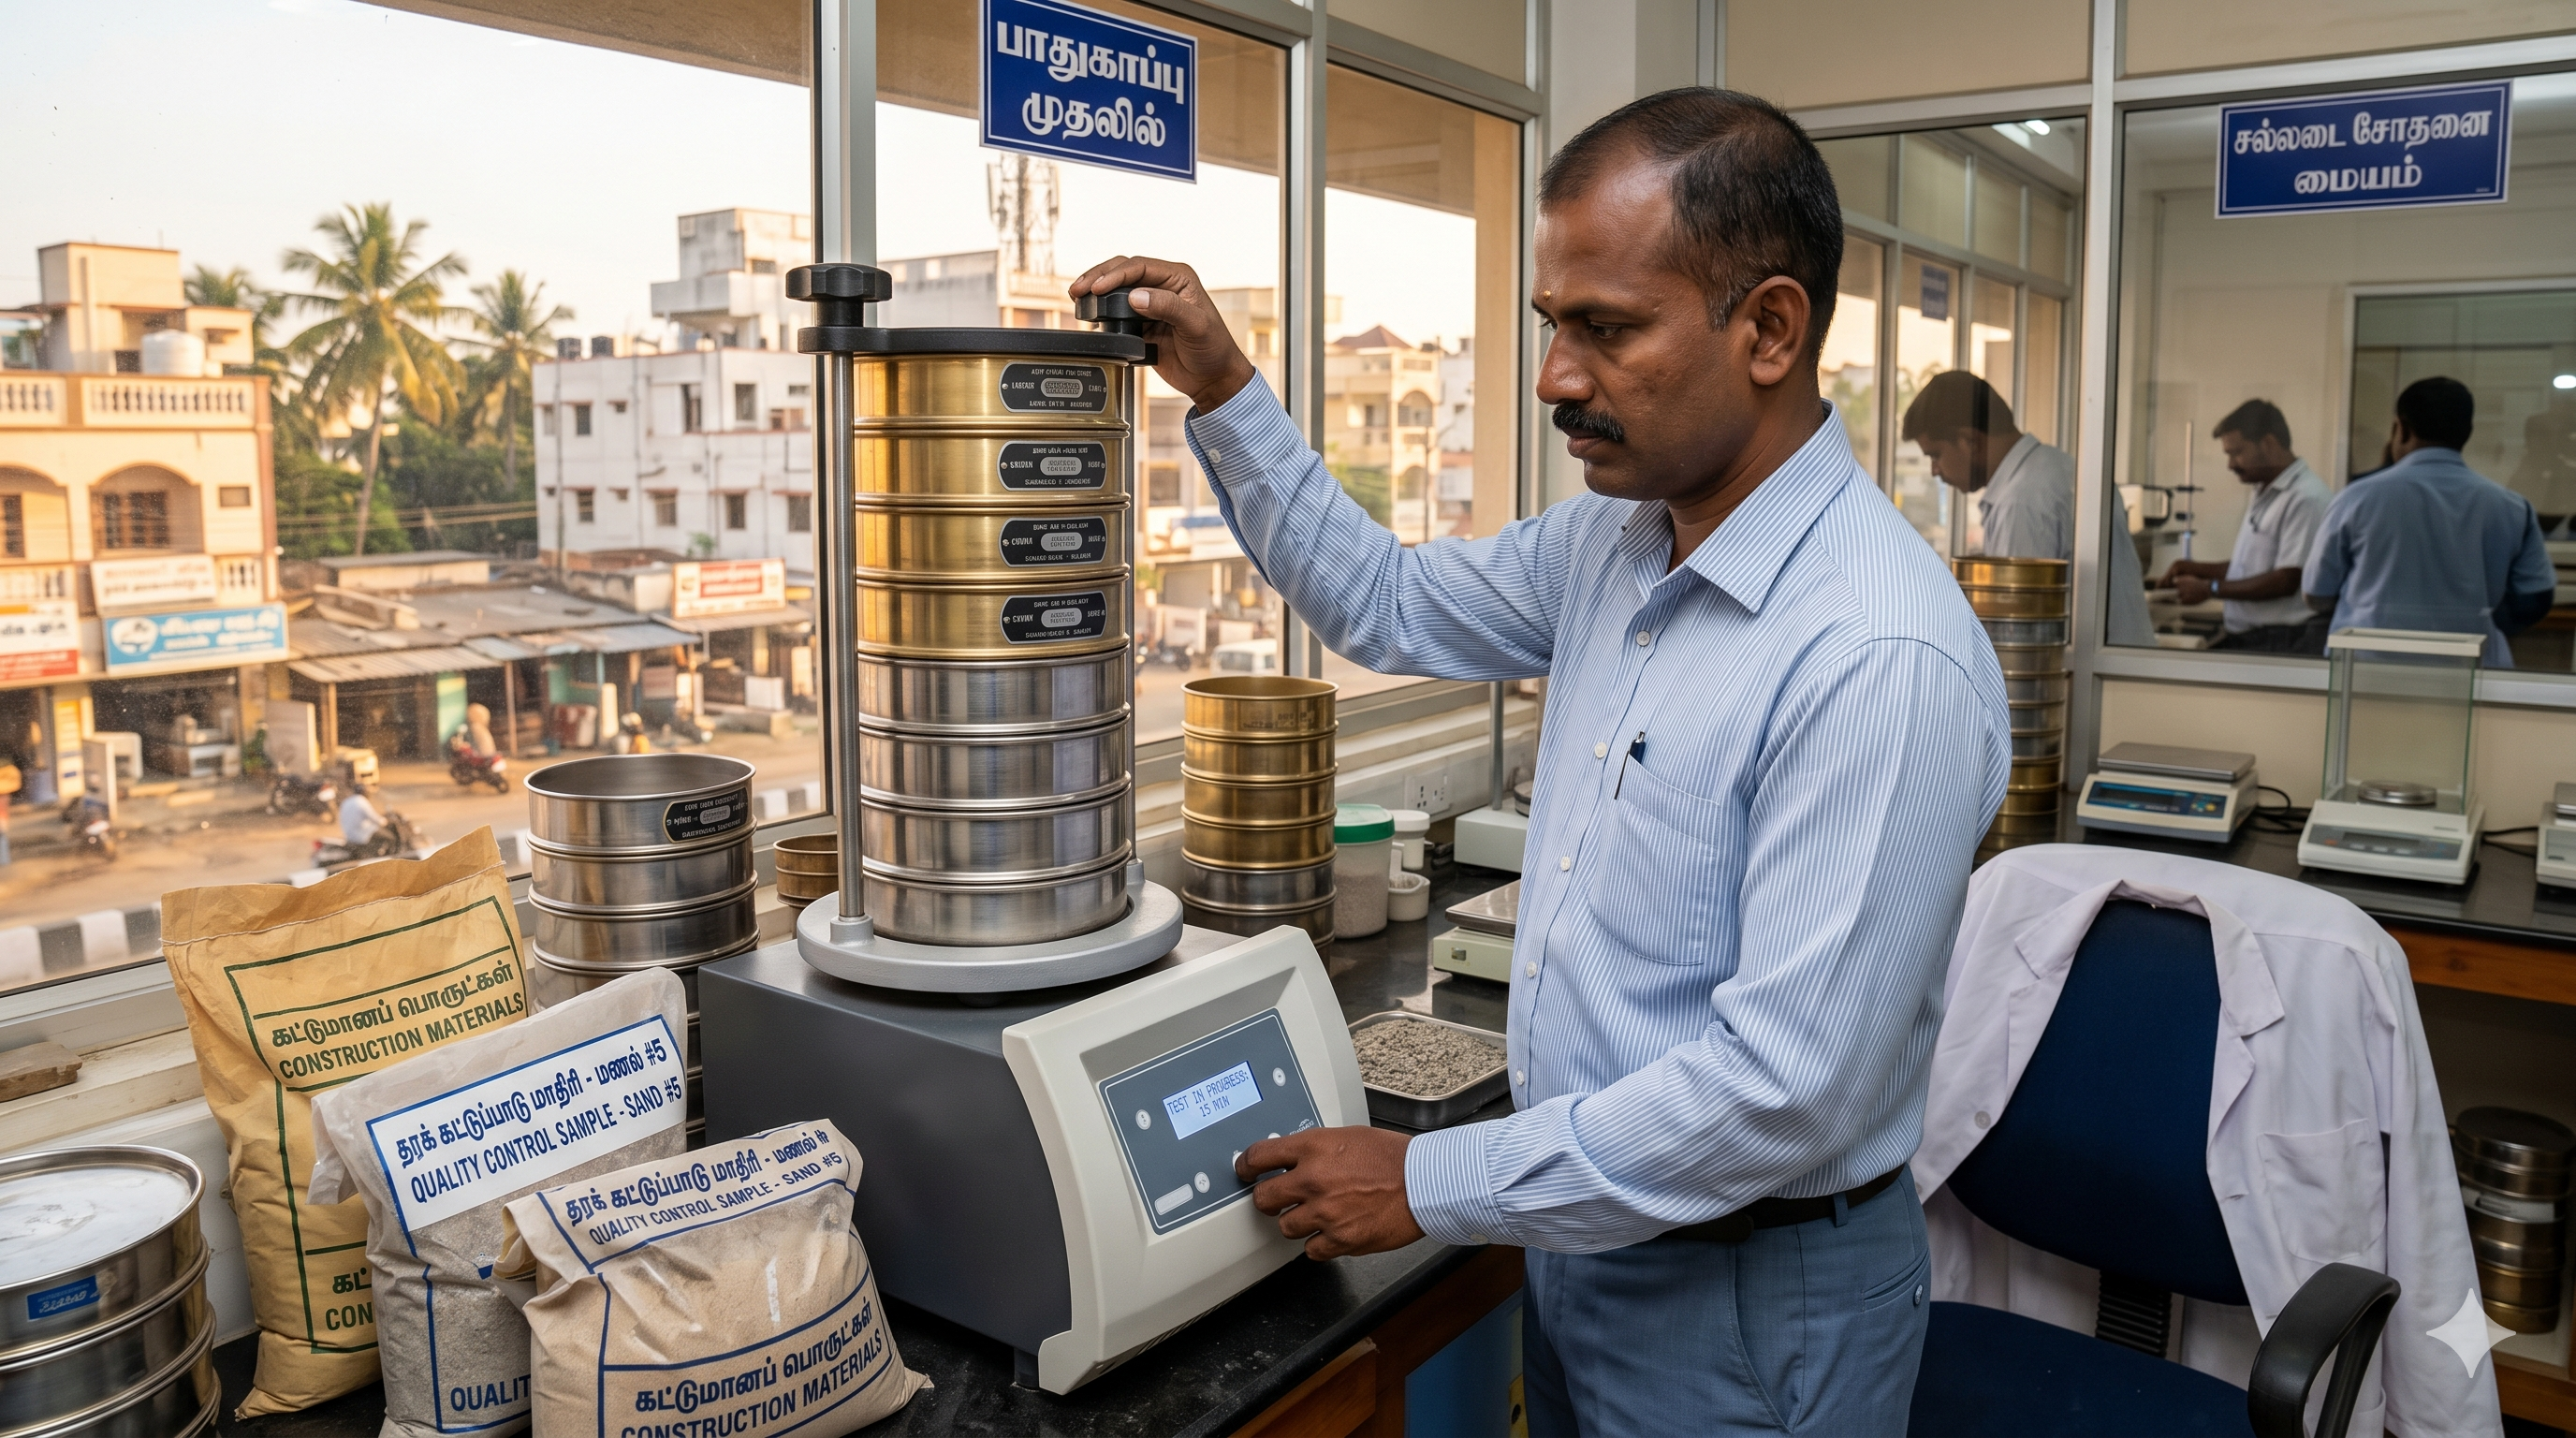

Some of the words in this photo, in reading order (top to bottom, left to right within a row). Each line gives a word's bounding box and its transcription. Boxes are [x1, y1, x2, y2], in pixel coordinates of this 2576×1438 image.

[997, 21, 1184, 104] பாதுகாப்பு
[1022, 92, 1165, 147] முதலில்
[2234, 118, 2346, 154] சல்லடை
[2352, 110, 2492, 151] சோதனை
[2293, 154, 2422, 194] மையம்
[272, 999, 393, 1046] கட்டுமானப்
[398, 960, 514, 1018] பொருட்கள்
[279, 1028, 424, 1079] CONSTRUCTION
[425, 991, 524, 1043] MATERIALS
[396, 1123, 437, 1169] தரக்
[438, 1091, 532, 1145] கட்டுப்பாடு
[530, 1068, 584, 1109] மாதிரி
[644, 1038, 667, 1066] #5
[411, 1153, 482, 1203] QUALITY
[483, 1127, 558, 1174] CONTROL
[555, 1102, 618, 1146] SAMPLE
[623, 1085, 664, 1118] SAND
[664, 1076, 682, 1103] #5
[1166, 1094, 1190, 1116] TEST
[1192, 1088, 1206, 1104] IN
[1199, 1103, 1211, 1117] 15
[565, 1187, 607, 1226] தரக்
[610, 1163, 710, 1207] கட்டுப்பாடு
[589, 1214, 649, 1245] QUALITY
[650, 1198, 717, 1225] CONTROL
[716, 1181, 774, 1209] SAMPLE
[782, 1163, 822, 1184] SAND
[636, 1356, 776, 1415] கட்டுமானப்
[783, 1296, 872, 1378] பொருட்கள்
[803, 1328, 882, 1407] MATERIALS
